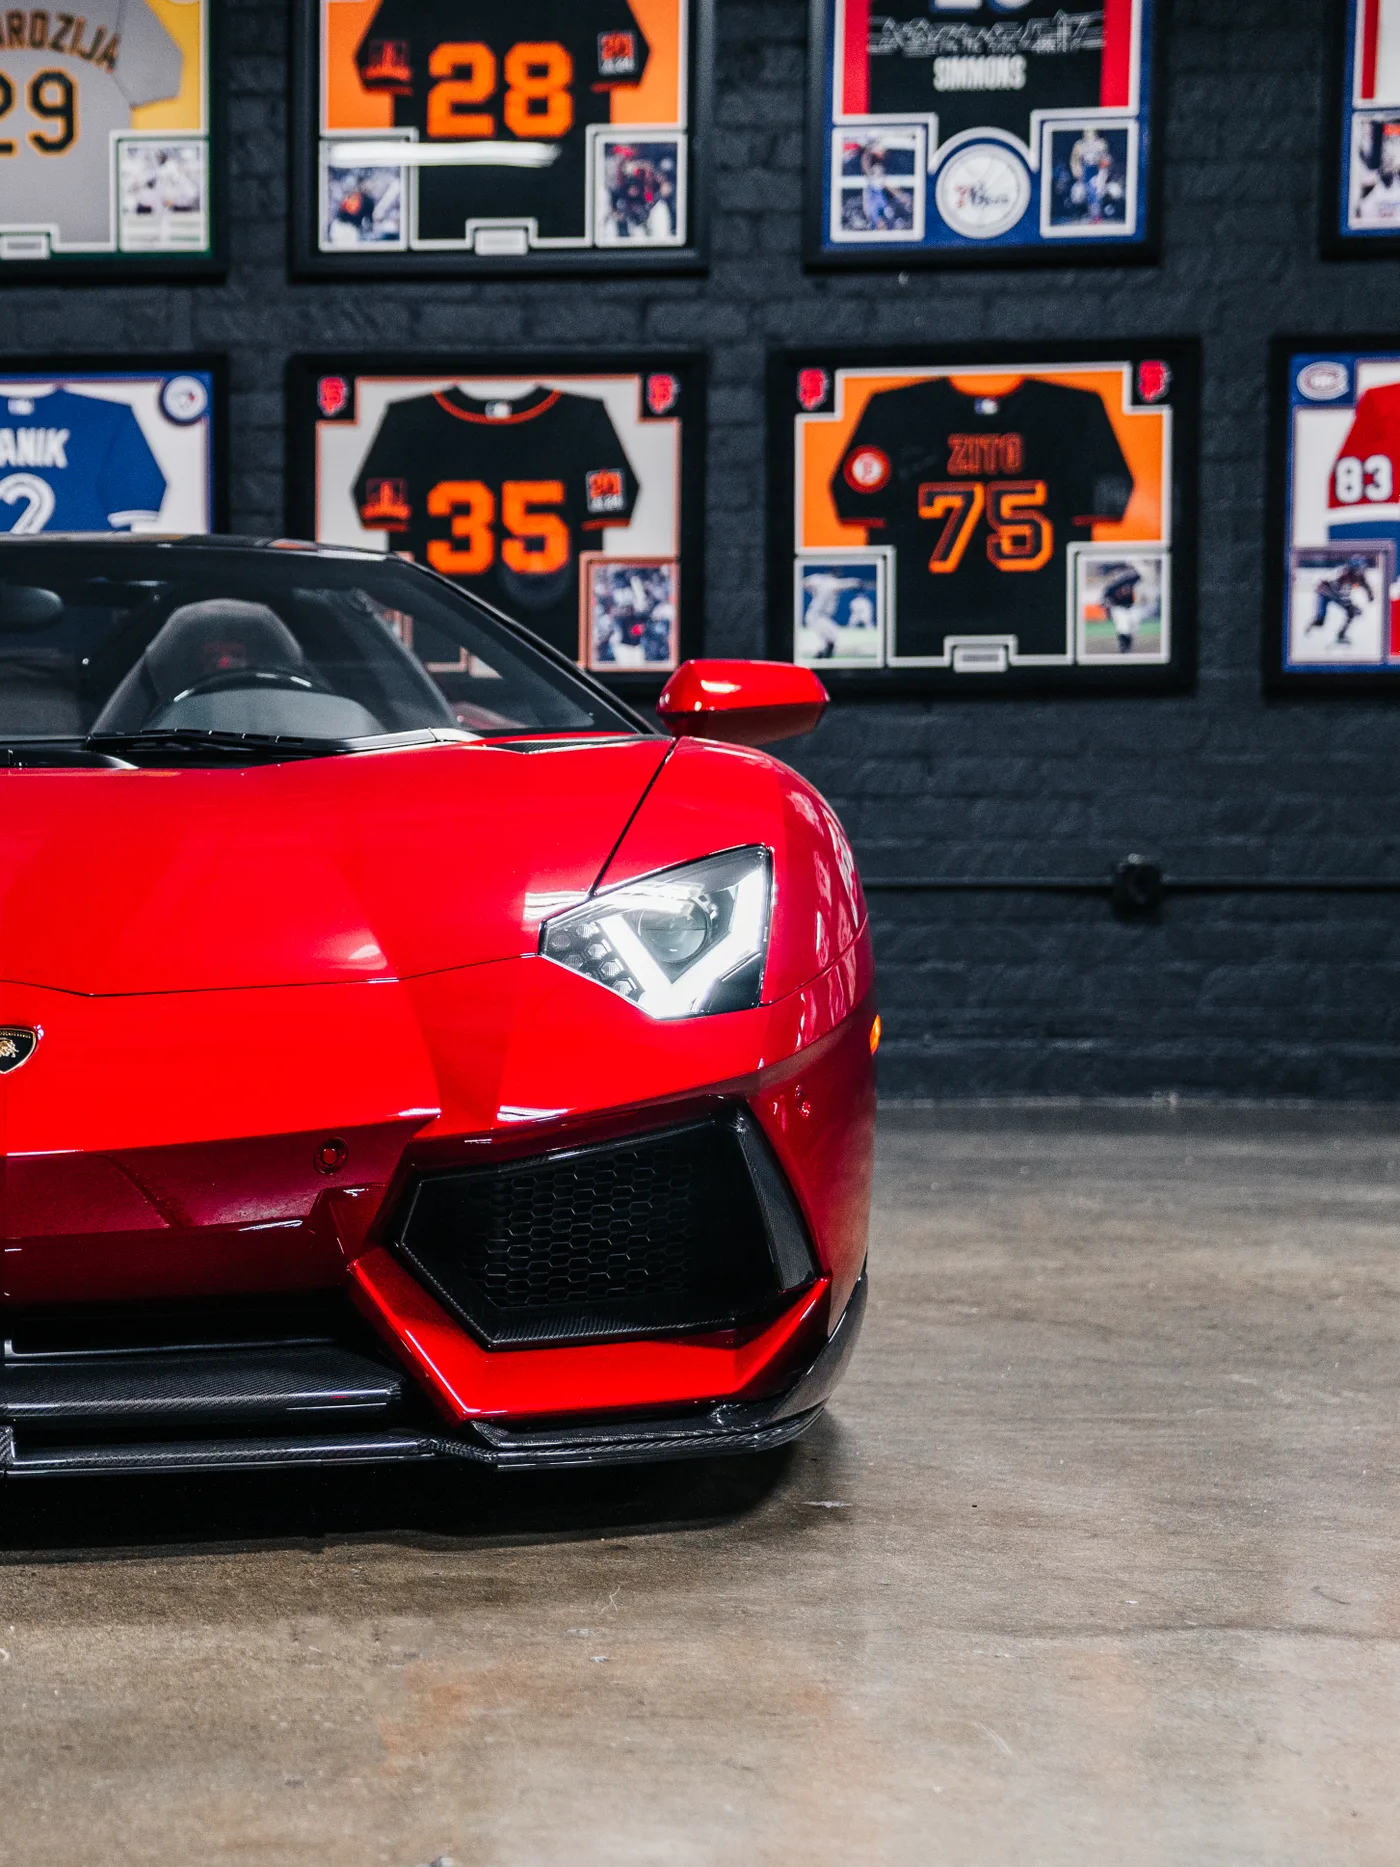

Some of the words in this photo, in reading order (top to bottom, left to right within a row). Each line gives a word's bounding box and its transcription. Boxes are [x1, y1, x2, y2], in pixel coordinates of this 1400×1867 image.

[427, 41, 573, 138] 28
[933, 55, 1027, 91] SIMMONS
[947, 432, 1023, 476] ZITO
[1335, 454, 1393, 503] 83
[426, 479, 571, 575] 35
[918, 480, 1054, 573] 75
